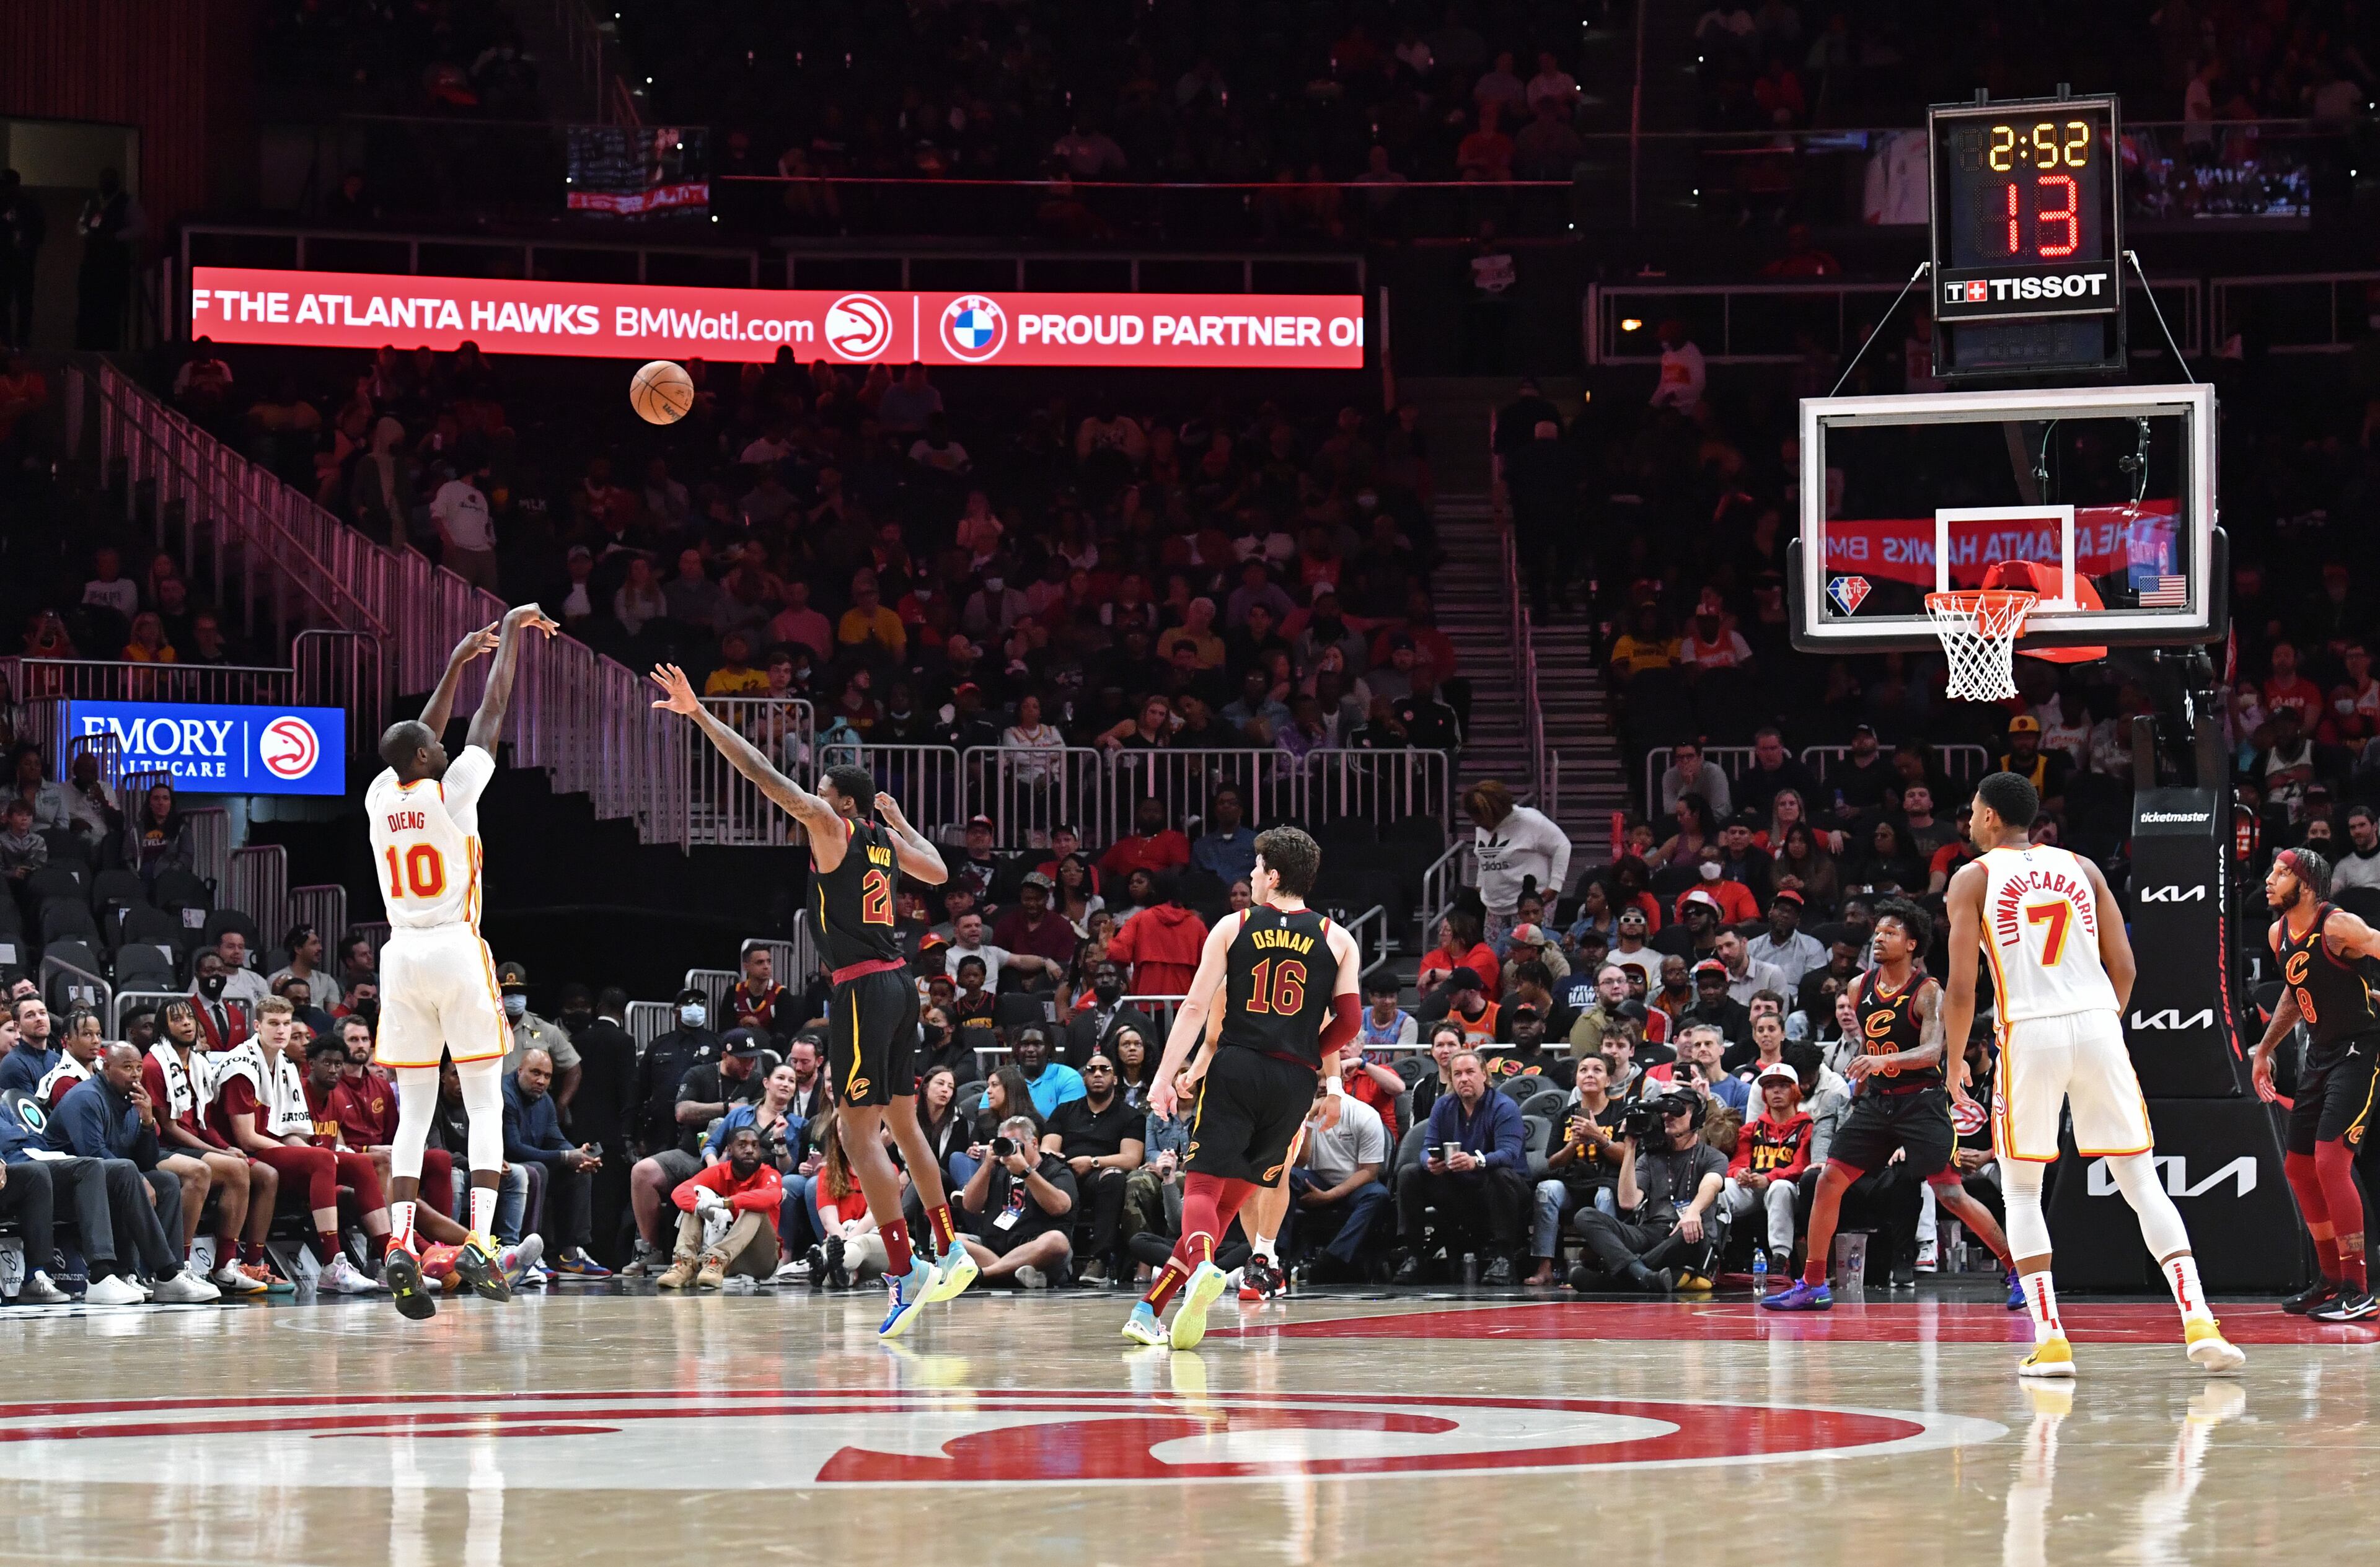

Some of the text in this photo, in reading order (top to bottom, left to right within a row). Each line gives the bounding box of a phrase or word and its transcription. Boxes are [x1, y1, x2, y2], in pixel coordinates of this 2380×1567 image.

[1990, 121, 2089, 172] 2:52
[2008, 175, 2079, 257] 13
[1989, 273, 2107, 301] TISSOT
[214, 290, 290, 323] THE
[294, 293, 464, 331] ATLANTA
[470, 301, 600, 336] HAWKS
[615, 306, 814, 344] BMWatl.com
[1018, 313, 1364, 348] PROUD PARTNER O
[1852, 582, 1861, 594] 75
[82, 716, 234, 757] EMORY
[387, 810, 425, 833] DIENG
[2140, 812, 2210, 823] ticketmaster
[384, 842, 447, 899] 10
[862, 869, 894, 927] 21
[1996, 871, 2096, 947] LUWAWU-CABARROT
[2140, 884, 2206, 902] KIA
[1251, 929, 1315, 955] OSMAN
[2024, 898, 2073, 967] 7
[1246, 957, 1307, 1016] 16
[1568, 991, 1596, 1004] HAW
[2131, 1008, 2214, 1030] KIA
[2295, 987, 2317, 1024] 8
[214, 1056, 260, 1080] GATORA
[281, 1110, 311, 1123] GATOR
